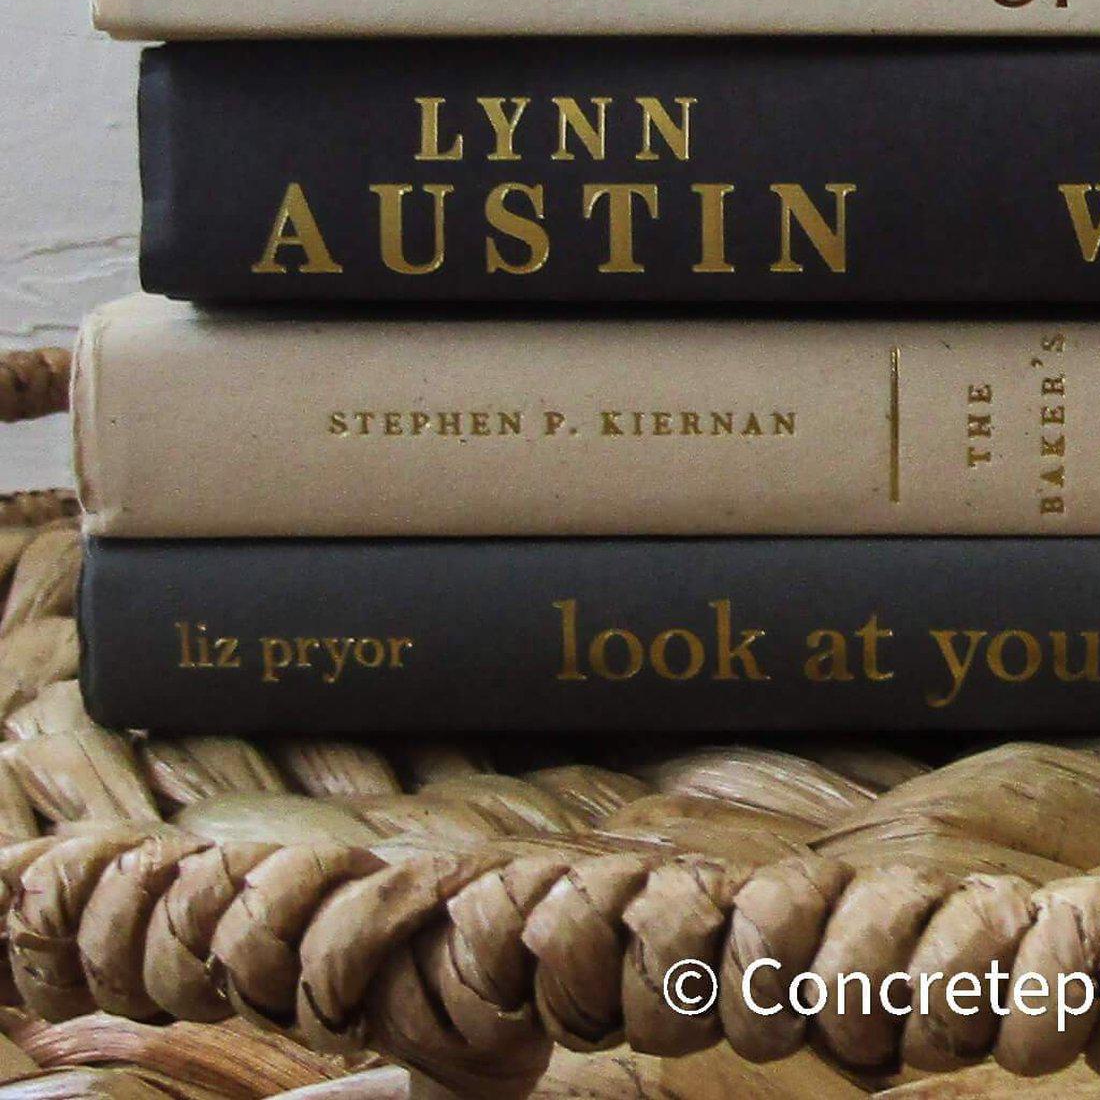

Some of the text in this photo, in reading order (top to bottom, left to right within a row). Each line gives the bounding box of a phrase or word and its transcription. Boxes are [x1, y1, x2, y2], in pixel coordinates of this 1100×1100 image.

[414, 97, 697, 161] LYNN
[251, 182, 857, 274] AUSTIN
[328, 411, 798, 437] STEPHEN P. KIERNAN
[967, 384, 992, 467] THE
[176, 621, 413, 683] liz pryor
[553, 600, 771, 681] look
[804, 613, 894, 682] at
